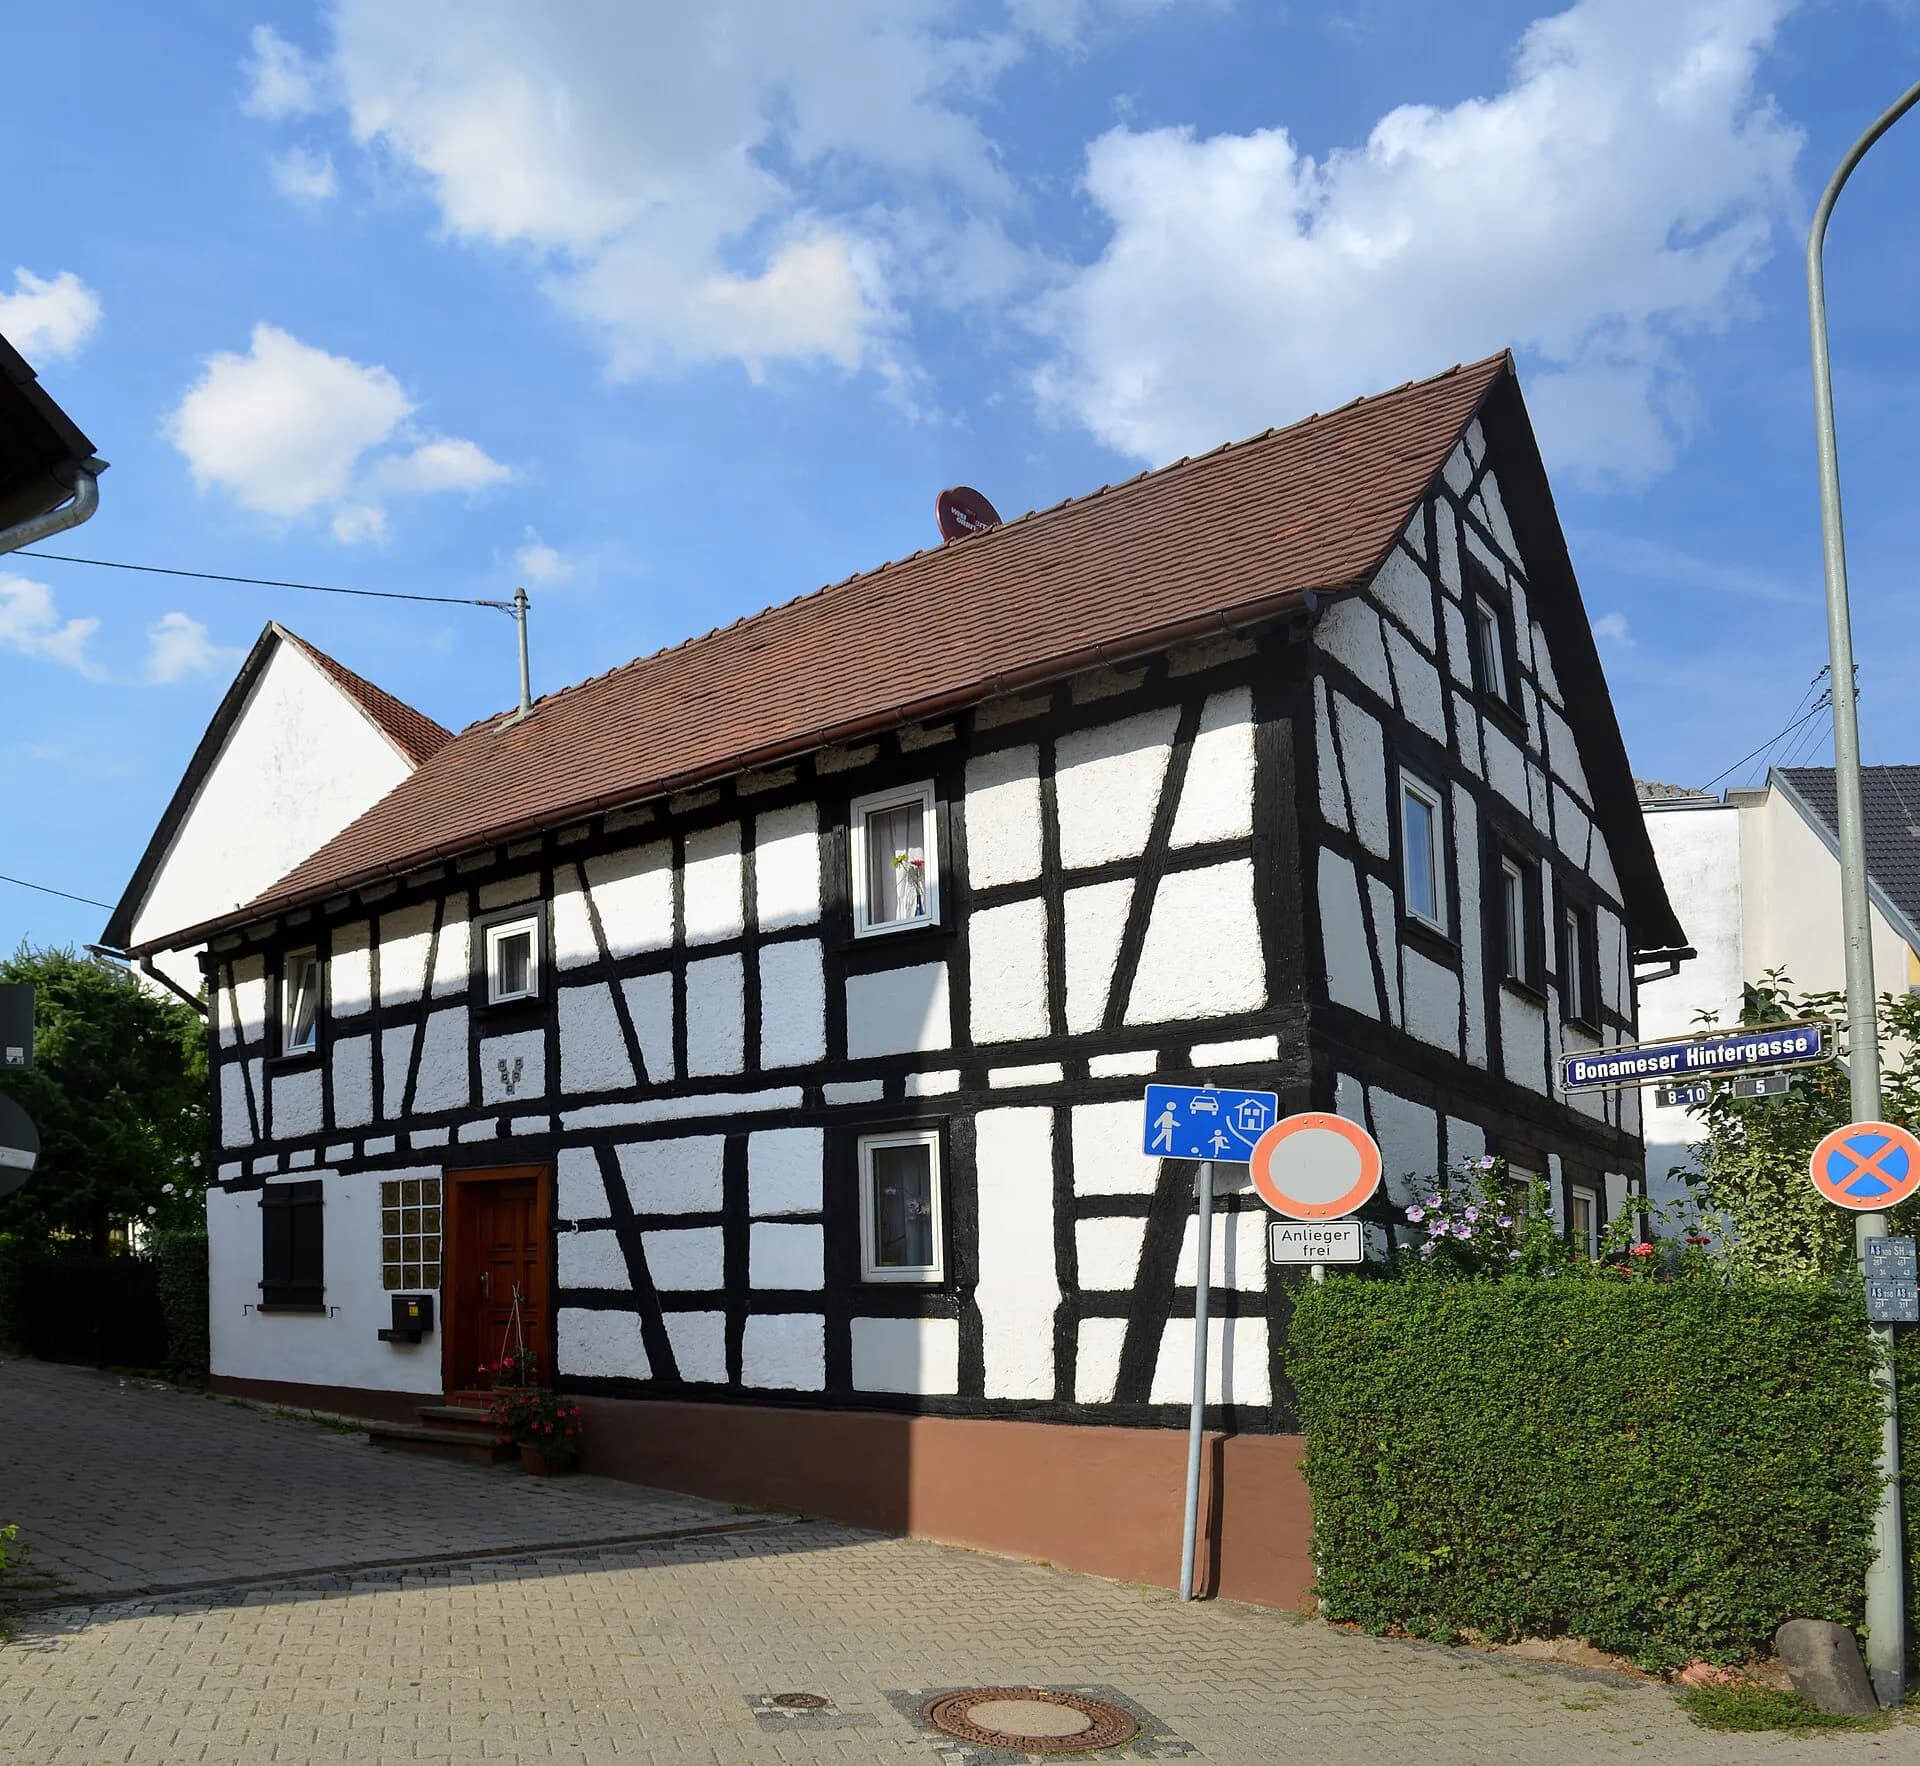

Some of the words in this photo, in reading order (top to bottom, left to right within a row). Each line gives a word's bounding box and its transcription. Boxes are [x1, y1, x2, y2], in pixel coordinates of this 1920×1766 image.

[1575, 1054, 1679, 1080] Bonameser
[1686, 1037, 1807, 1068] Hintergasse
[1755, 1080, 1766, 1094] 5
[1667, 1087, 1705, 1104] 8-10
[571, 1216, 579, 1234] 5
[1281, 1229, 1351, 1244] Anlieger
[1303, 1244, 1331, 1257] frei
[1870, 1245, 1881, 1256] AS
[1893, 1245, 1905, 1256] SH
[1871, 1287, 1882, 1298] AS
[1896, 1287, 1906, 1298] AS
